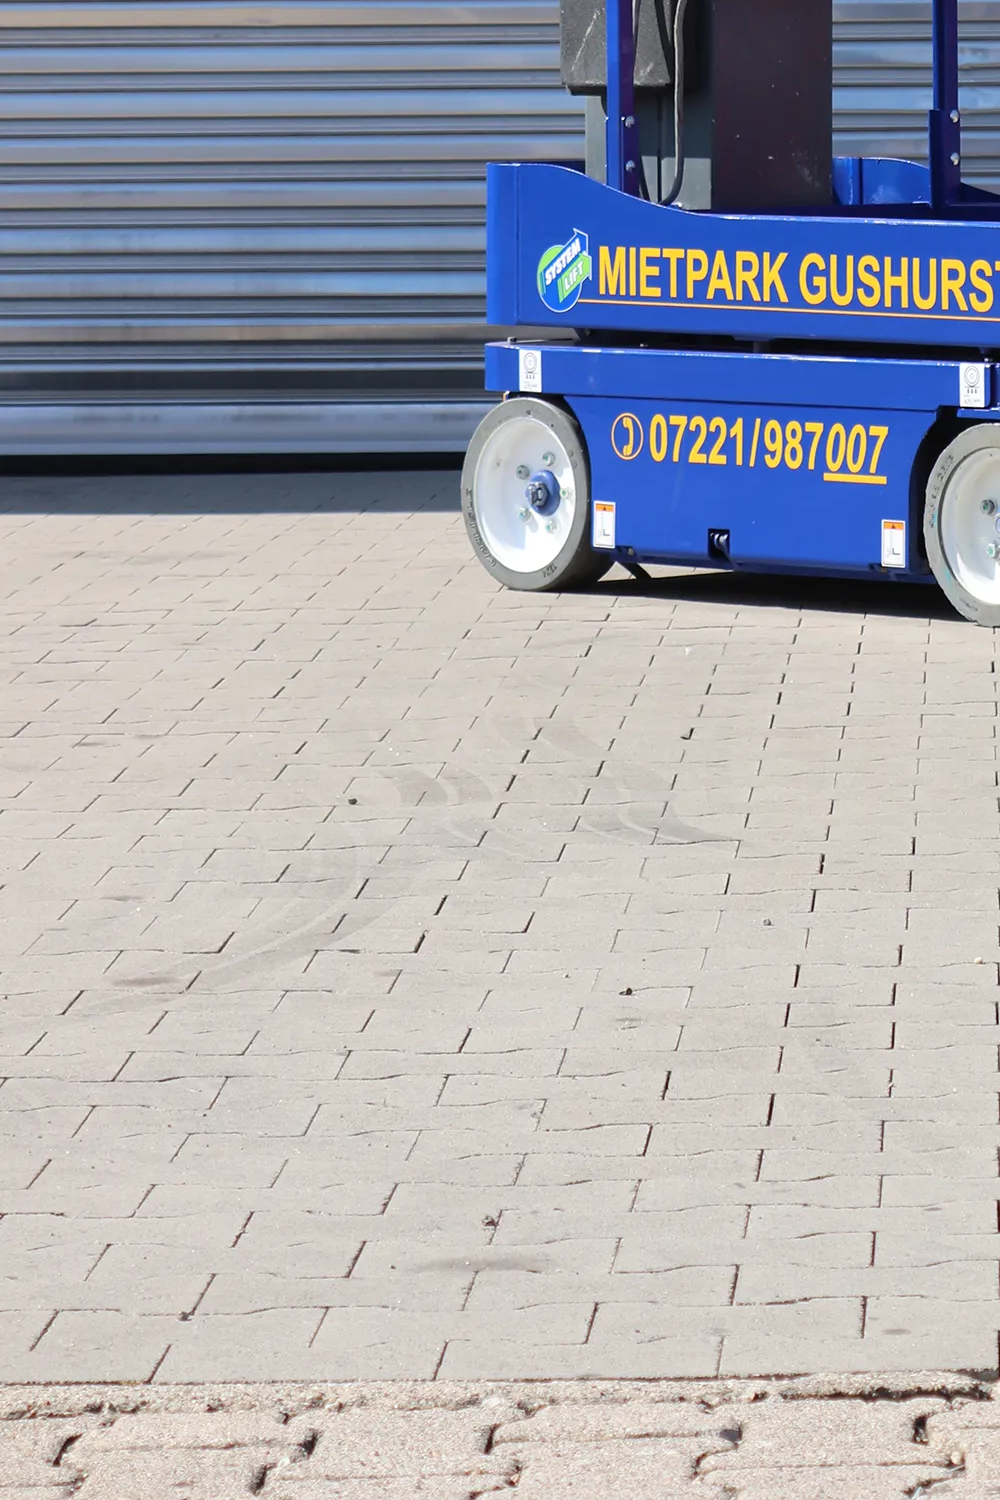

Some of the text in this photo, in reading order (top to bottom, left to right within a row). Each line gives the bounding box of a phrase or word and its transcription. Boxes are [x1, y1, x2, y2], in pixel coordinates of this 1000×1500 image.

[544, 237, 581, 286] SYSTEM
[564, 260, 584, 291] LIFT
[599, 246, 789, 304] MIETPARK
[649, 413, 889, 476] 07221/987007
